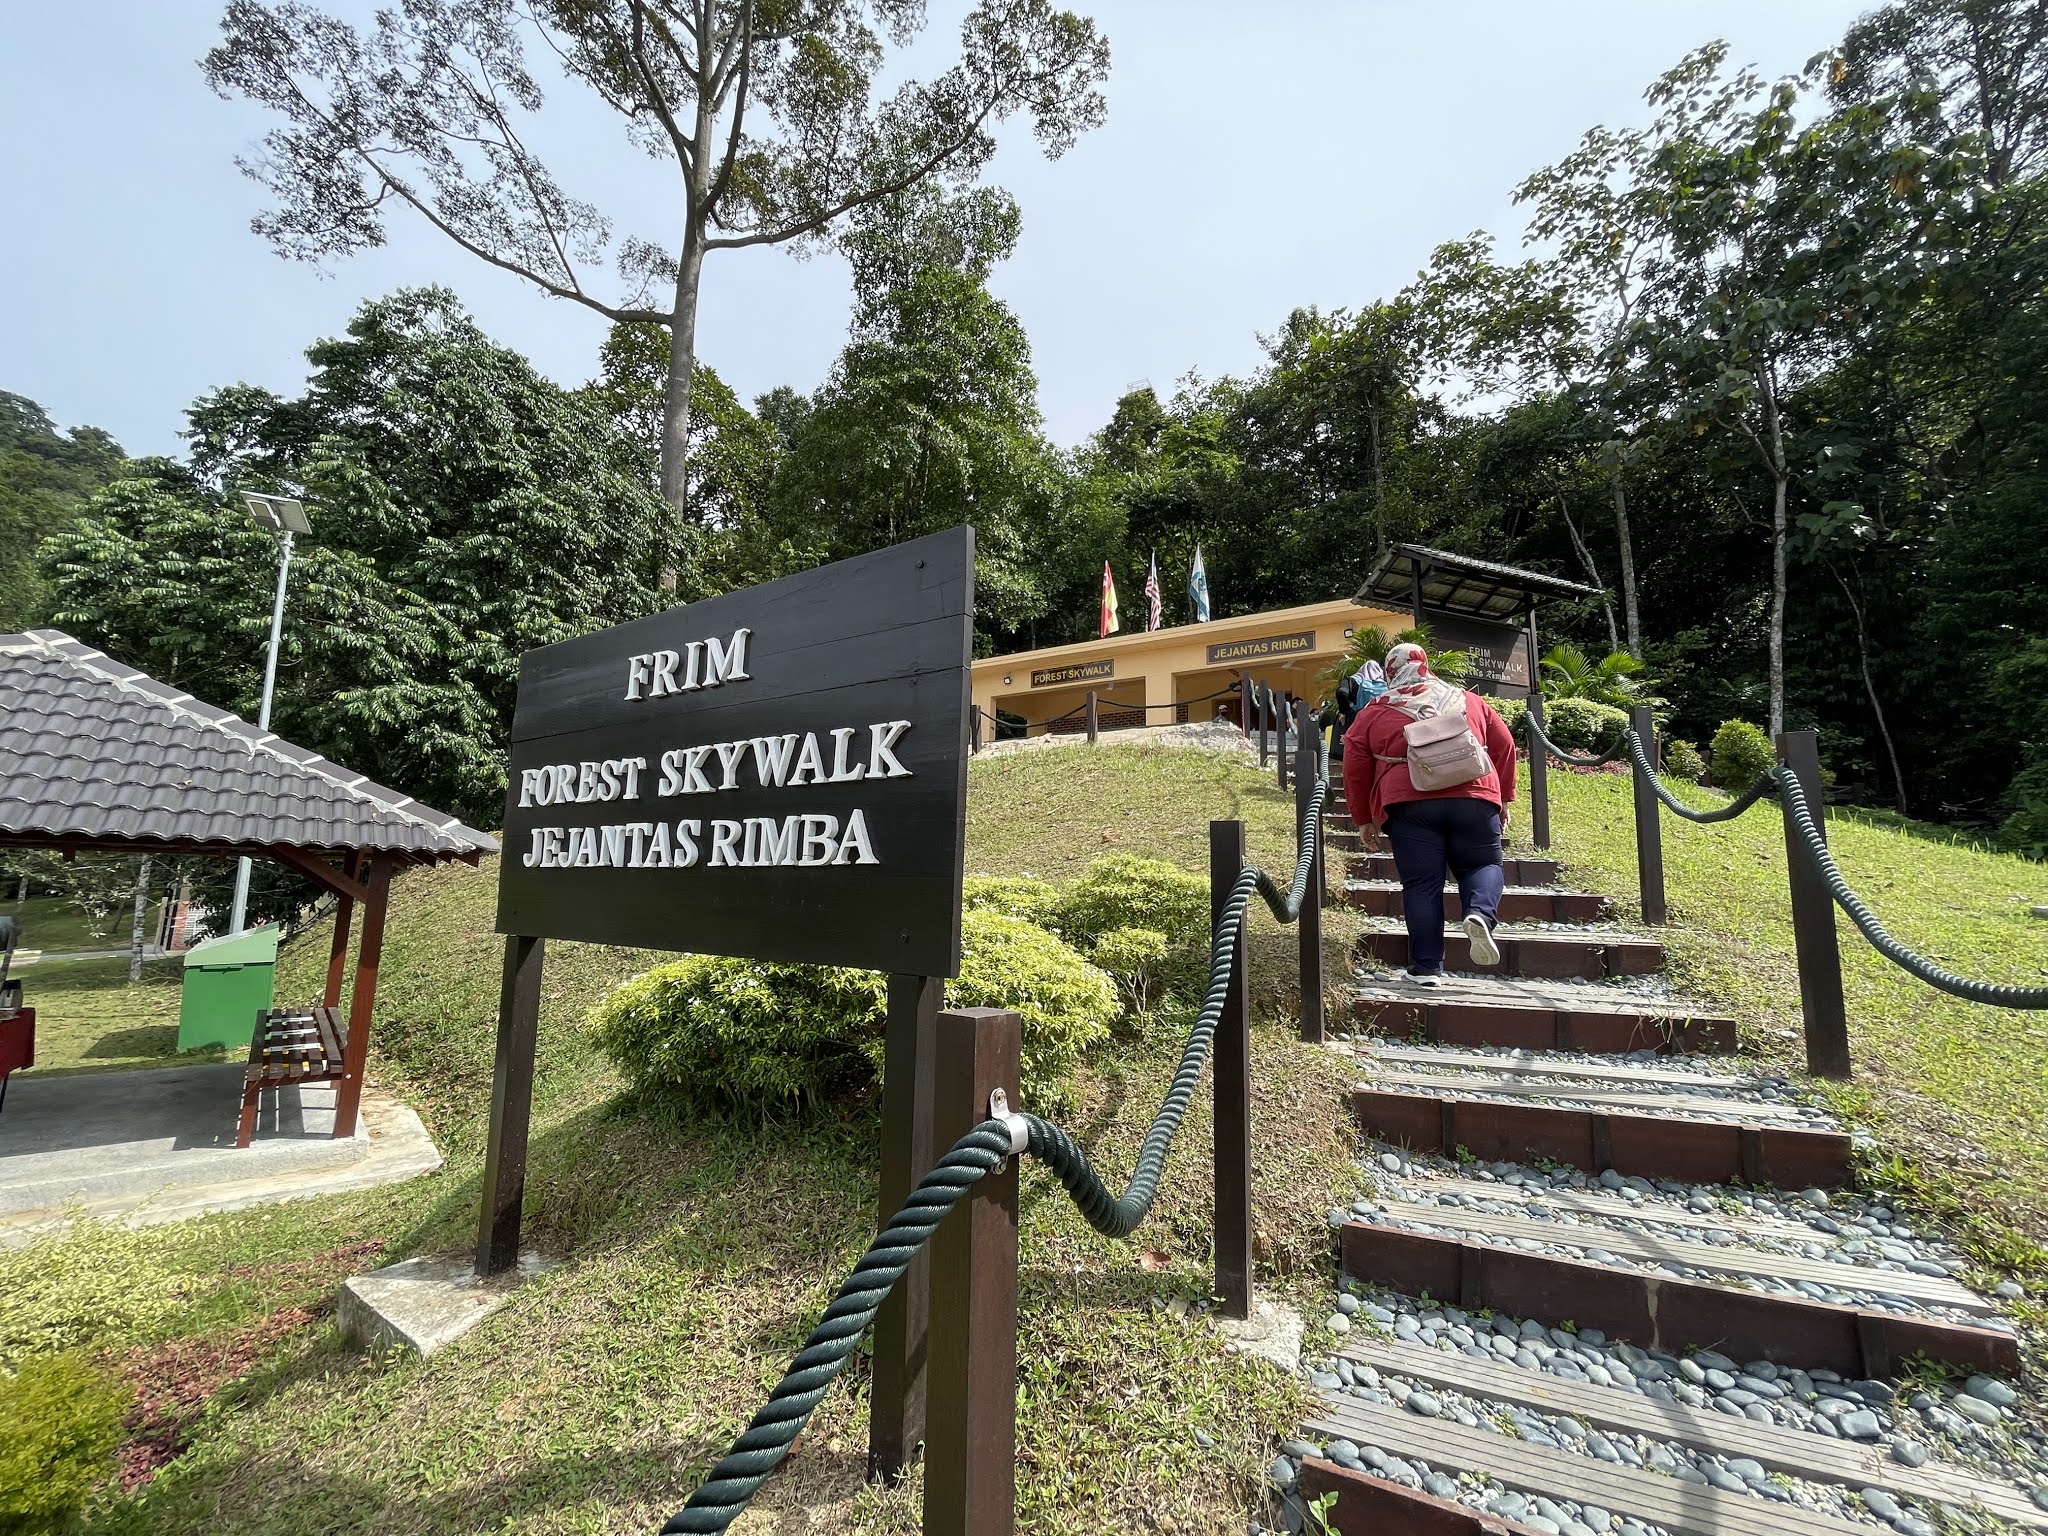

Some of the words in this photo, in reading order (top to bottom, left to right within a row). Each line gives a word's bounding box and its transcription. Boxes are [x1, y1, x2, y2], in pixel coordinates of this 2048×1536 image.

[1214, 643, 1268, 659] JEJANTAS
[1271, 638, 1308, 651] RIMBA
[1469, 646, 1491, 658] FRIM
[623, 628, 751, 701] FRIM
[1034, 671, 1067, 684] FOREST
[1068, 664, 1111, 679] SKYWALK
[1479, 658, 1523, 672] SKYWALK
[517, 756, 647, 808] FOREST
[657, 719, 913, 798] SKYWALK
[522, 818, 701, 869] JEJANTAS
[707, 808, 880, 868] RIMBA
